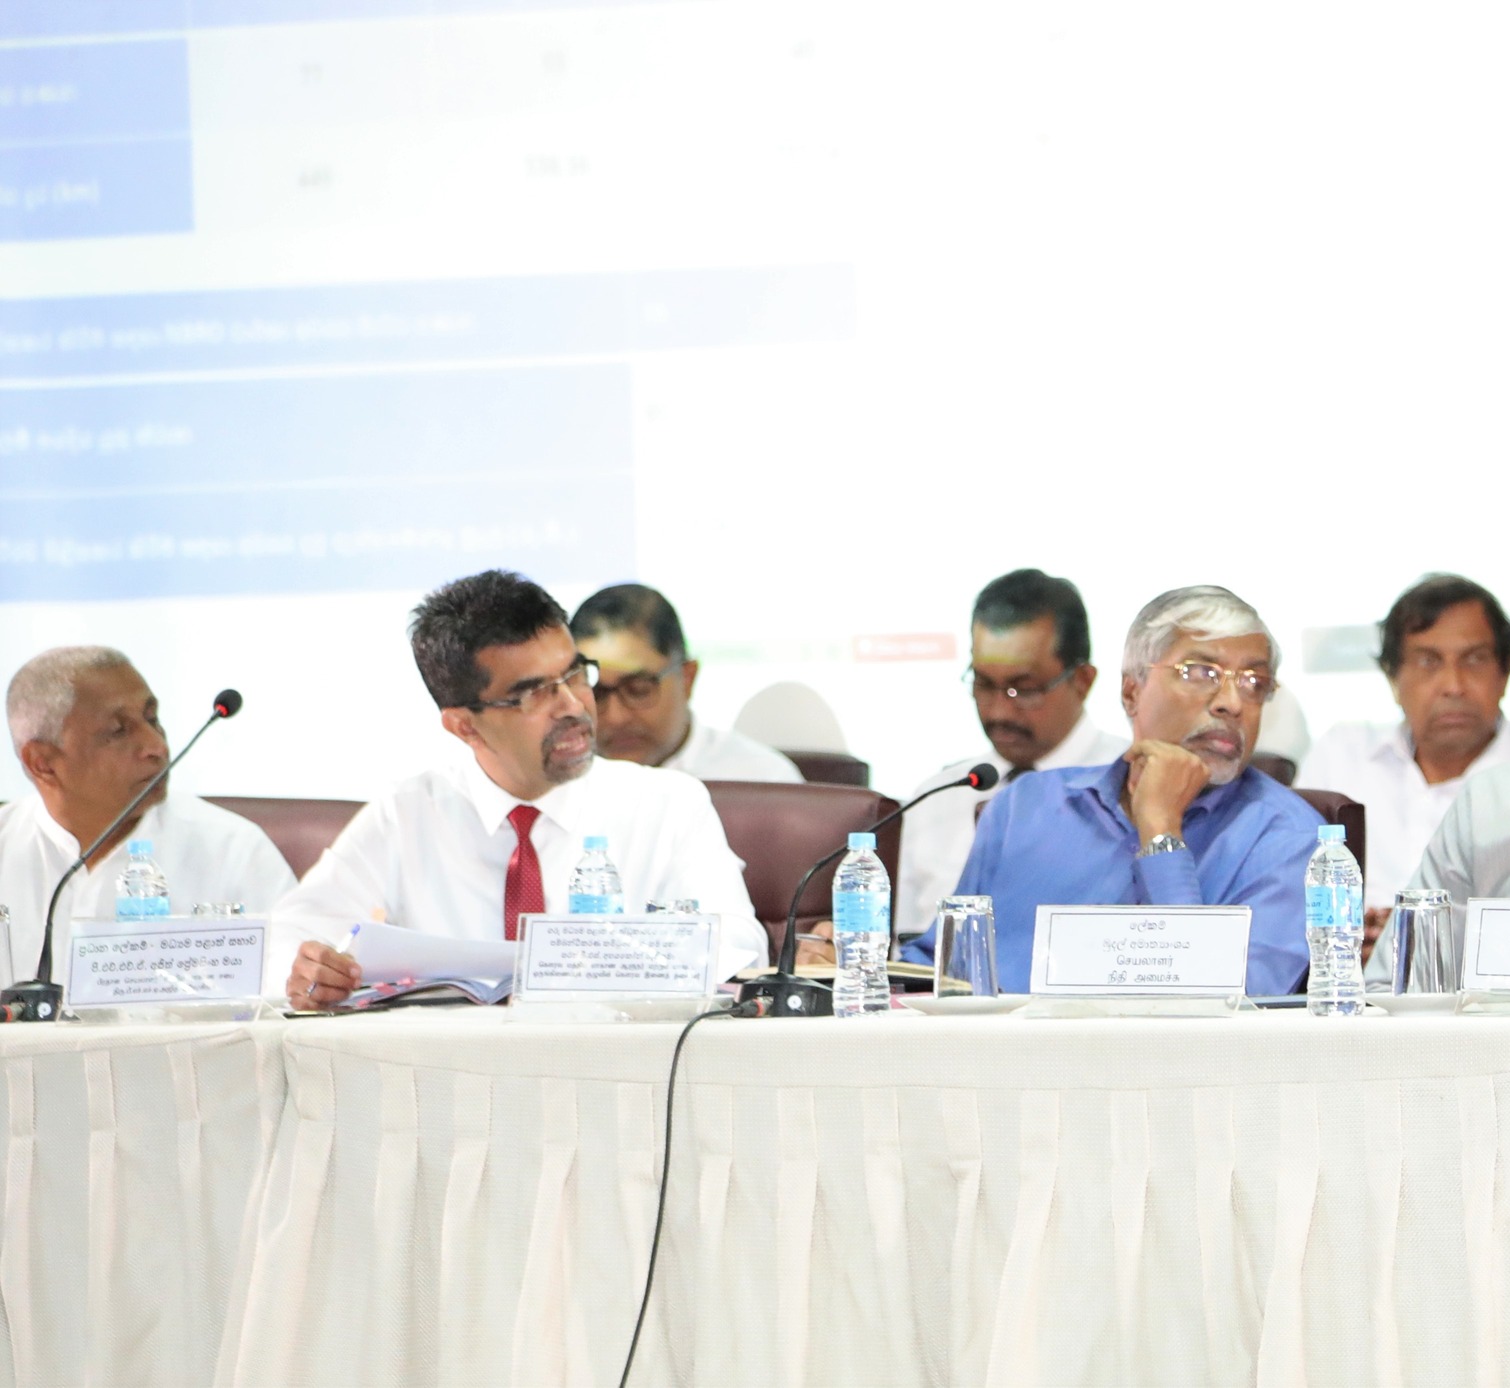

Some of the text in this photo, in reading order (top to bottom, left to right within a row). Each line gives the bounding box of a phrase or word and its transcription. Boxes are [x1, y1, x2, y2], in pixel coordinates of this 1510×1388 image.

[1130, 919, 1166, 932] ලේකම්
[79, 943, 109, 957] ප්‍රධාන
[112, 940, 148, 954] ලේකම්
[160, 937, 192, 949] මධ්‍යම
[195, 935, 226, 950] පළාත්
[228, 935, 257, 947] සභාව
[1103, 938, 1127, 952] මුදල්
[222, 955, 243, 966] මයා
[1117, 955, 1174, 967] செயலாளர்
[1108, 970, 1180, 984] நிதி அமைச்சு
